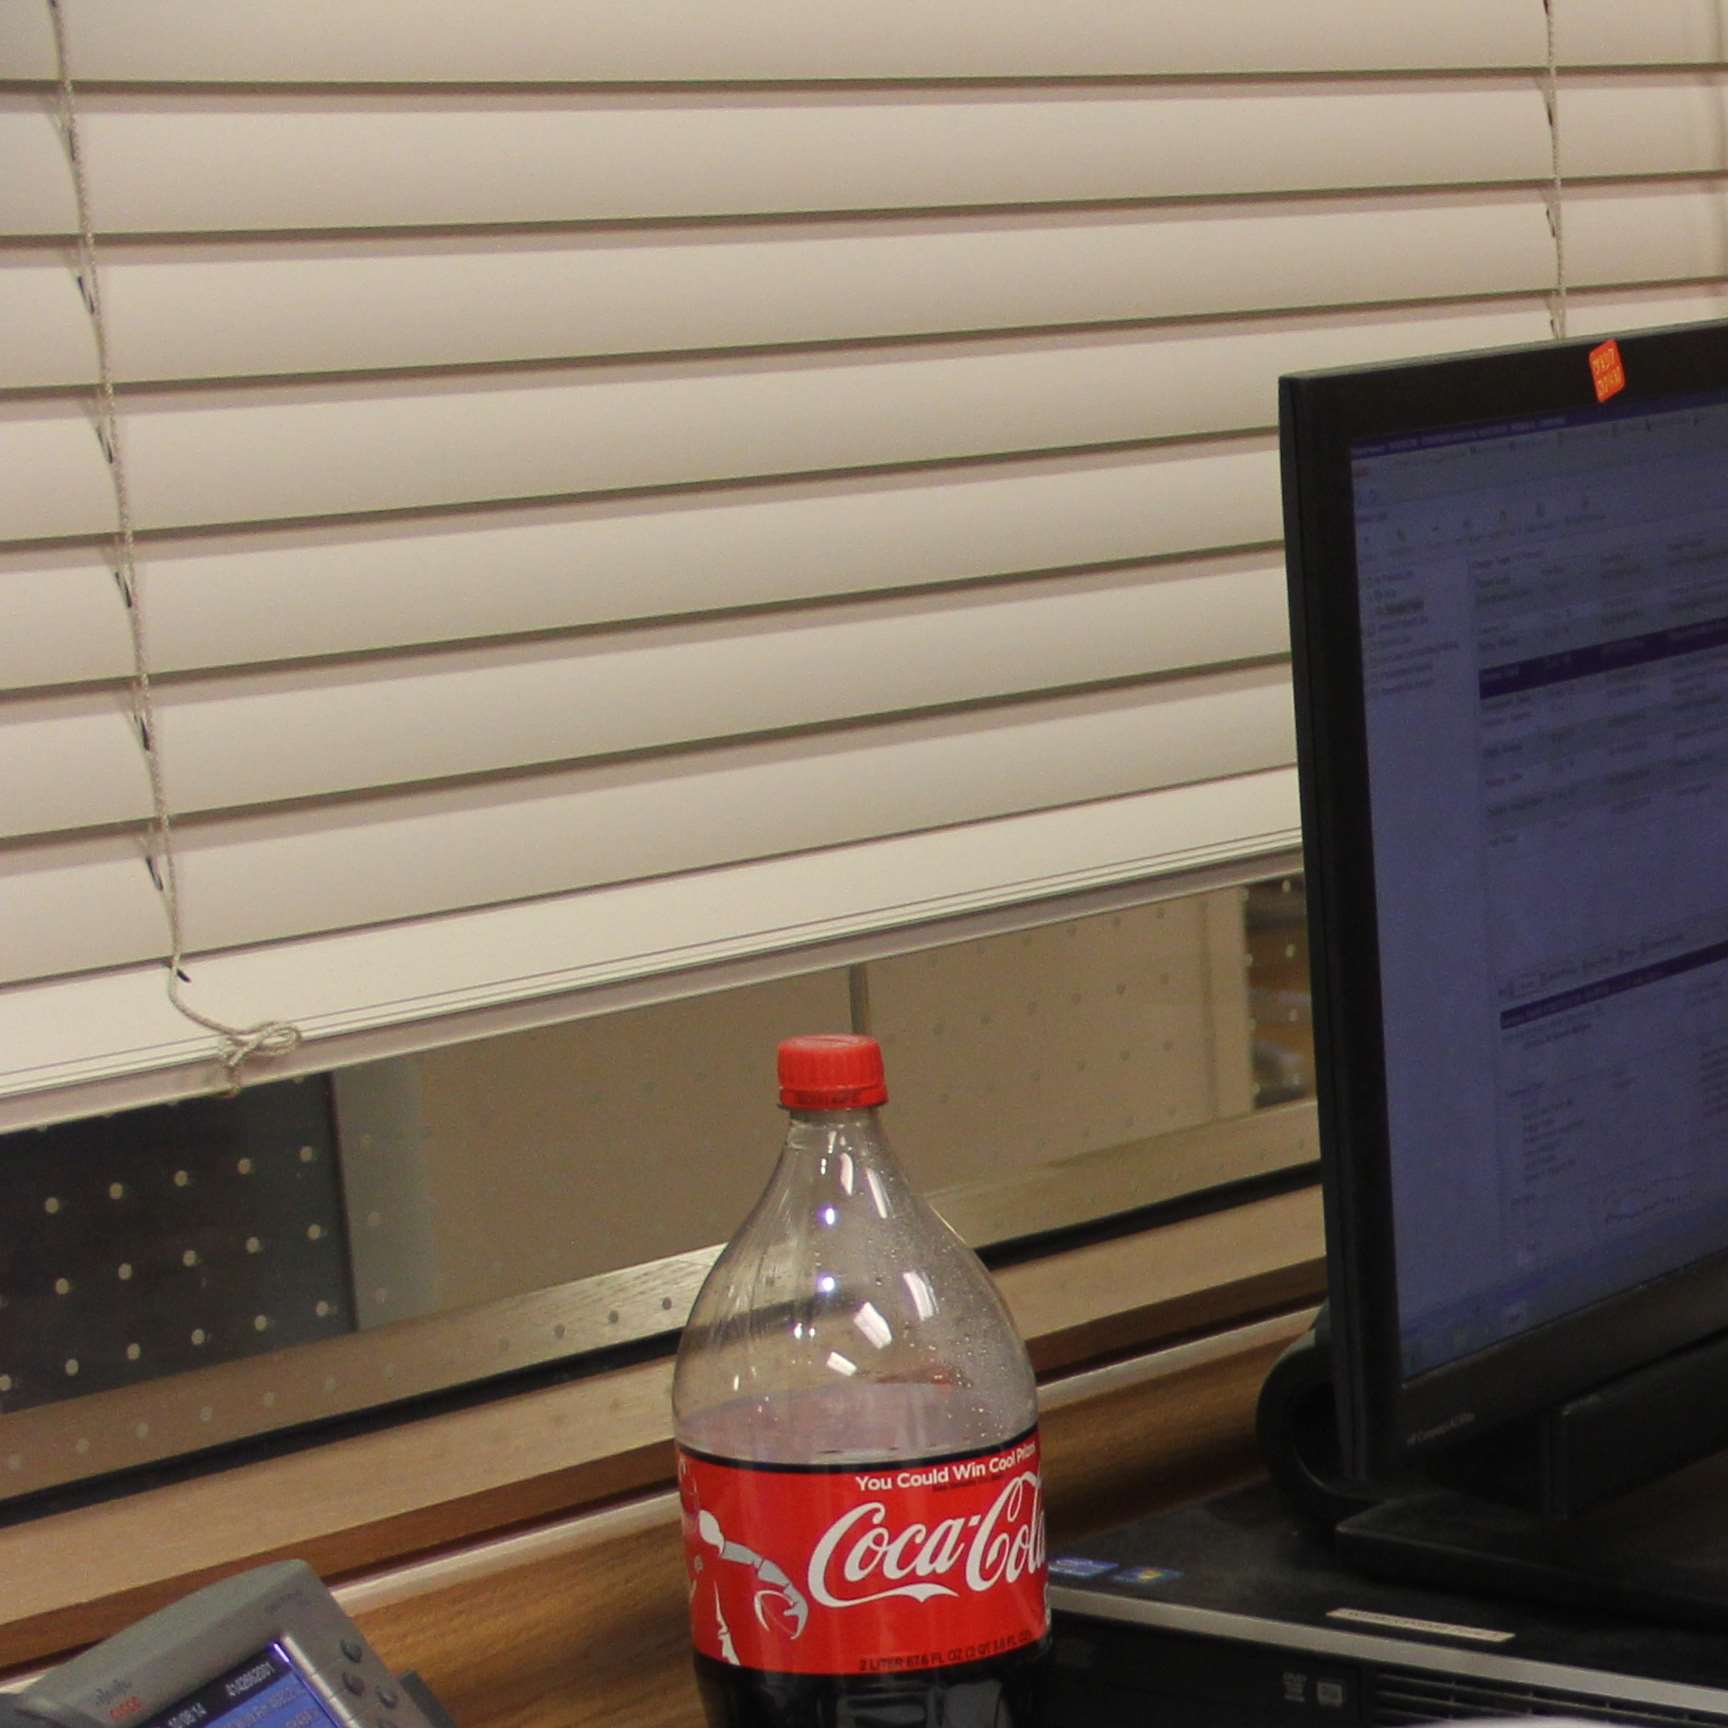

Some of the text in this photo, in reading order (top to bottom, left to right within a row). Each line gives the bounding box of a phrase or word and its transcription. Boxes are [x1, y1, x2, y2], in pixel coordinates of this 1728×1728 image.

[856, 1476, 892, 1492] You
[897, 1467, 949, 1489] Could
[952, 1463, 986, 1481] Win
[989, 1453, 1017, 1473] Cool
[808, 1471, 1046, 1608] Coca-Cola
